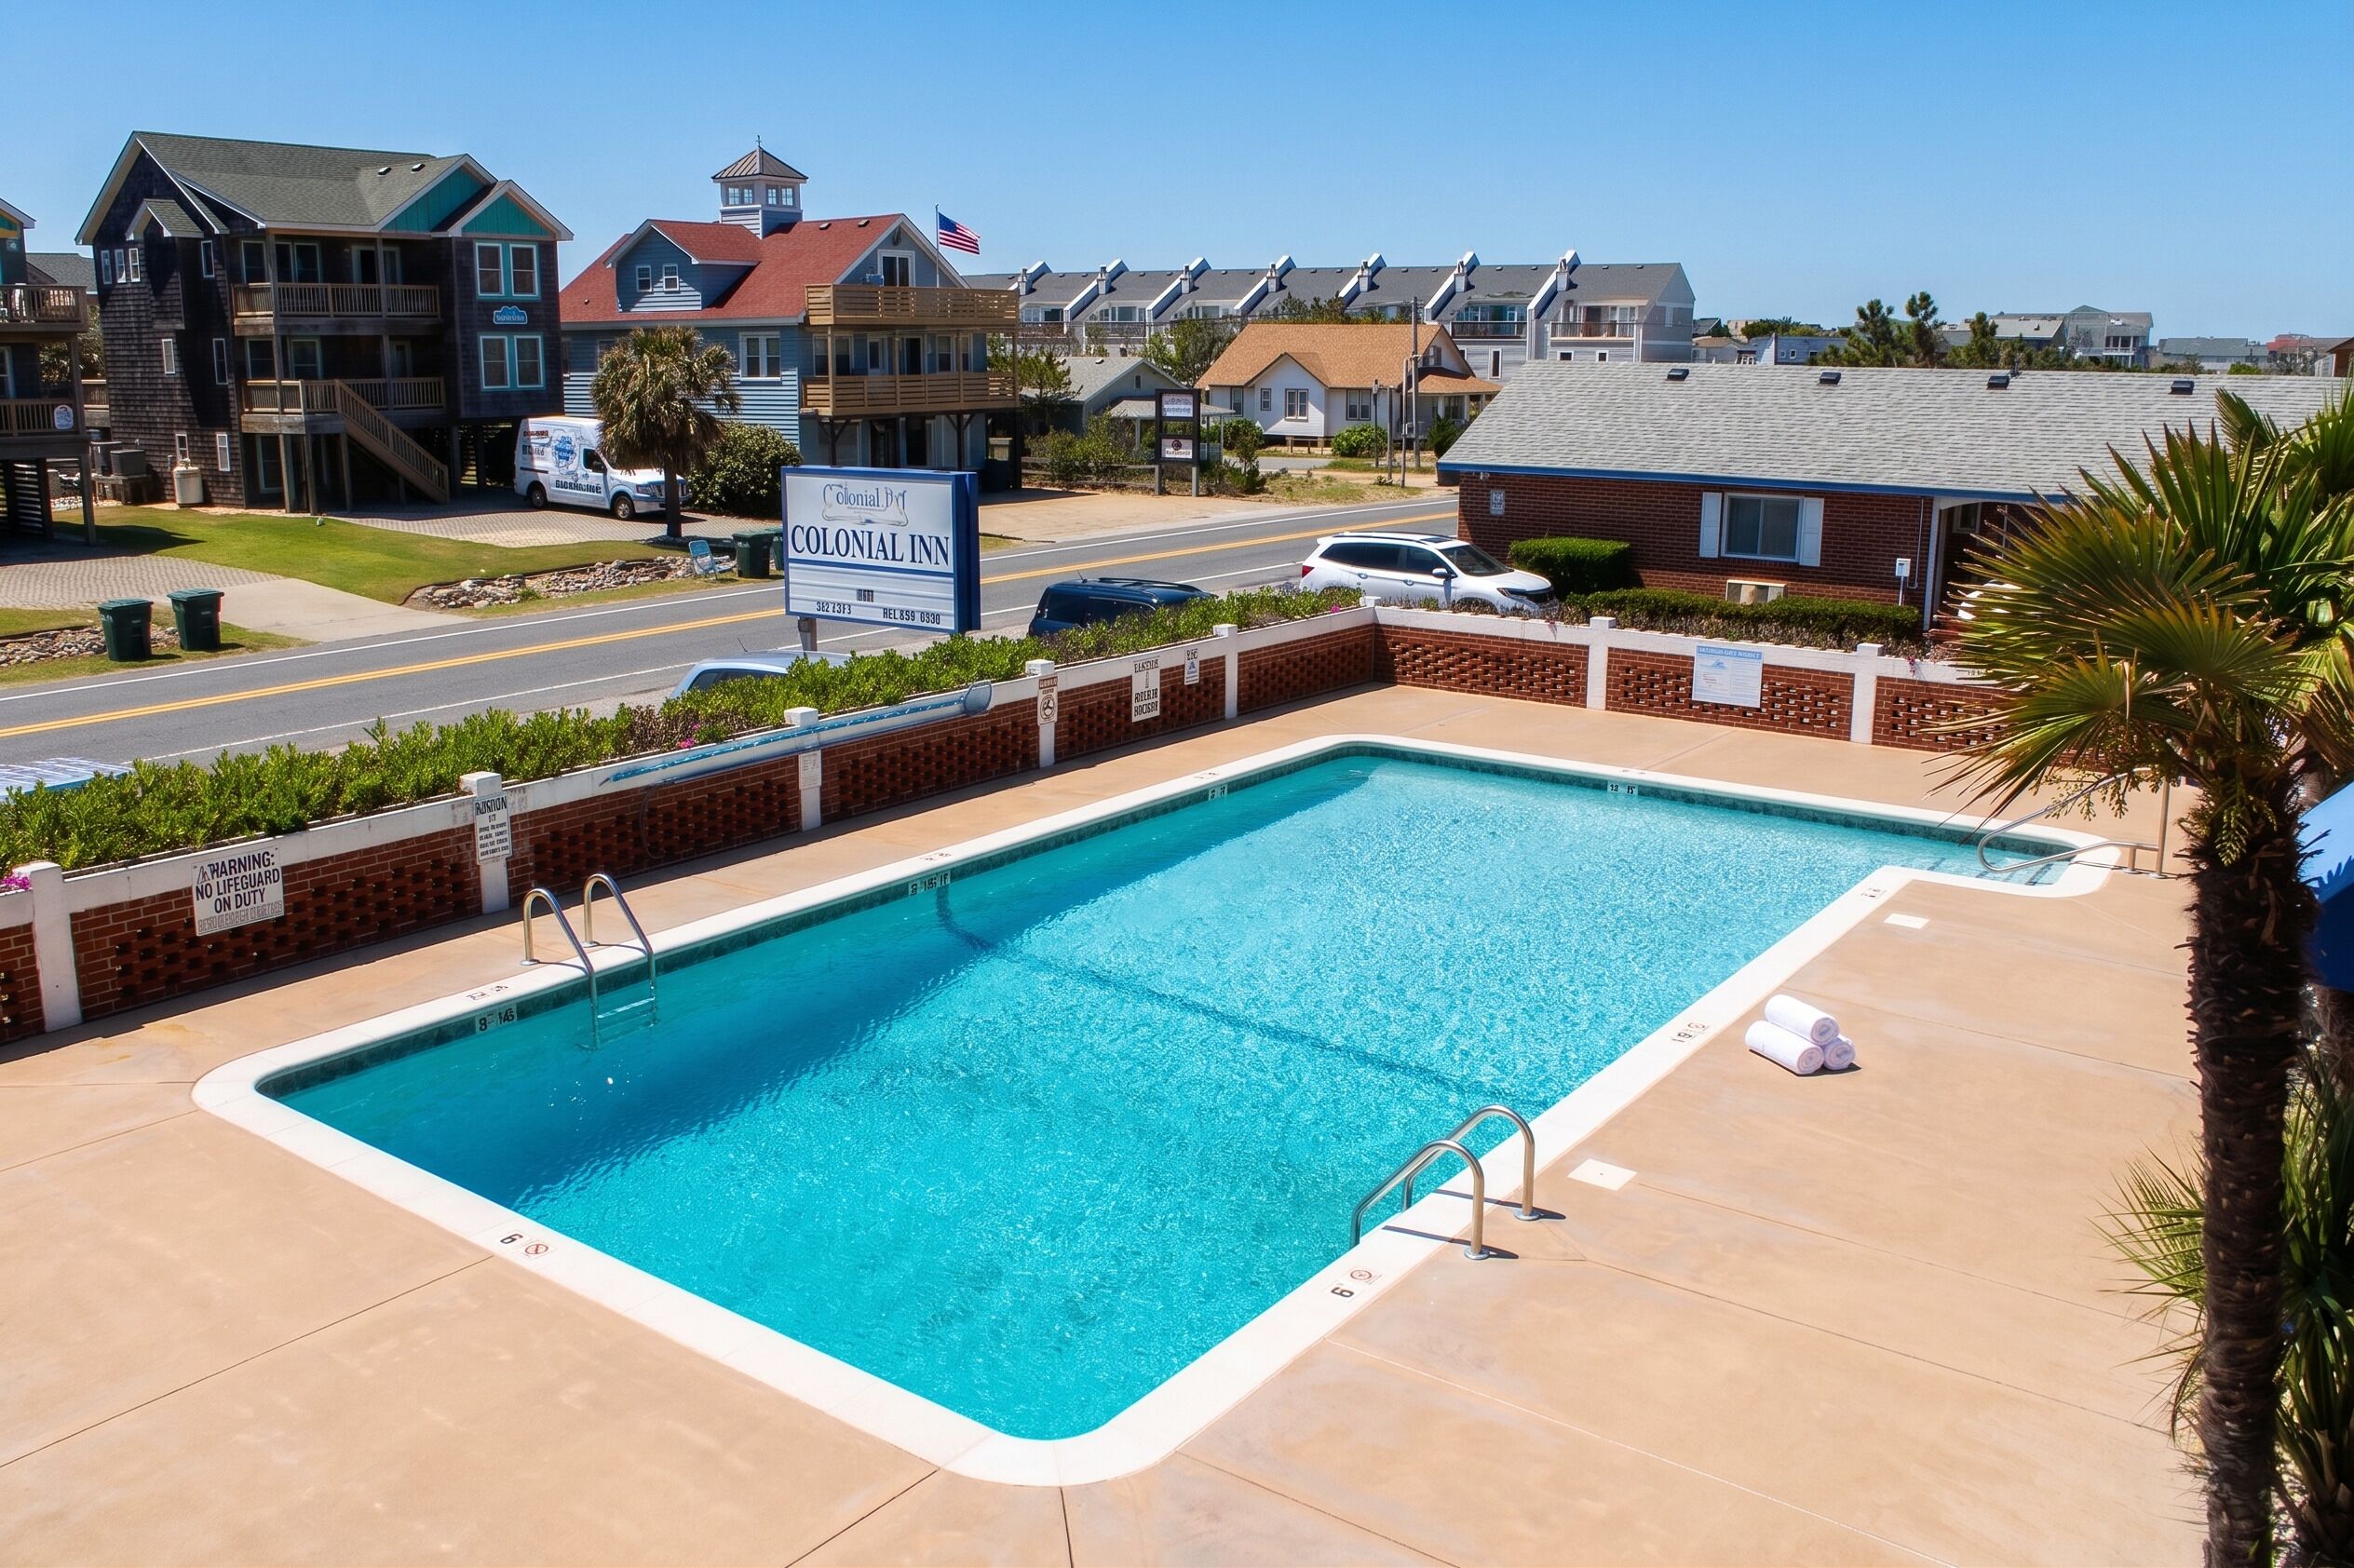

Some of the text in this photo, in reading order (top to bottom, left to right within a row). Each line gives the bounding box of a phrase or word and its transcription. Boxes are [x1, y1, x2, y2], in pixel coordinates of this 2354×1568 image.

[791, 525, 950, 566] COLONIAL INN
[196, 868, 280, 900] NO LIFEGUARD
[214, 887, 266, 913] ON DUTY
